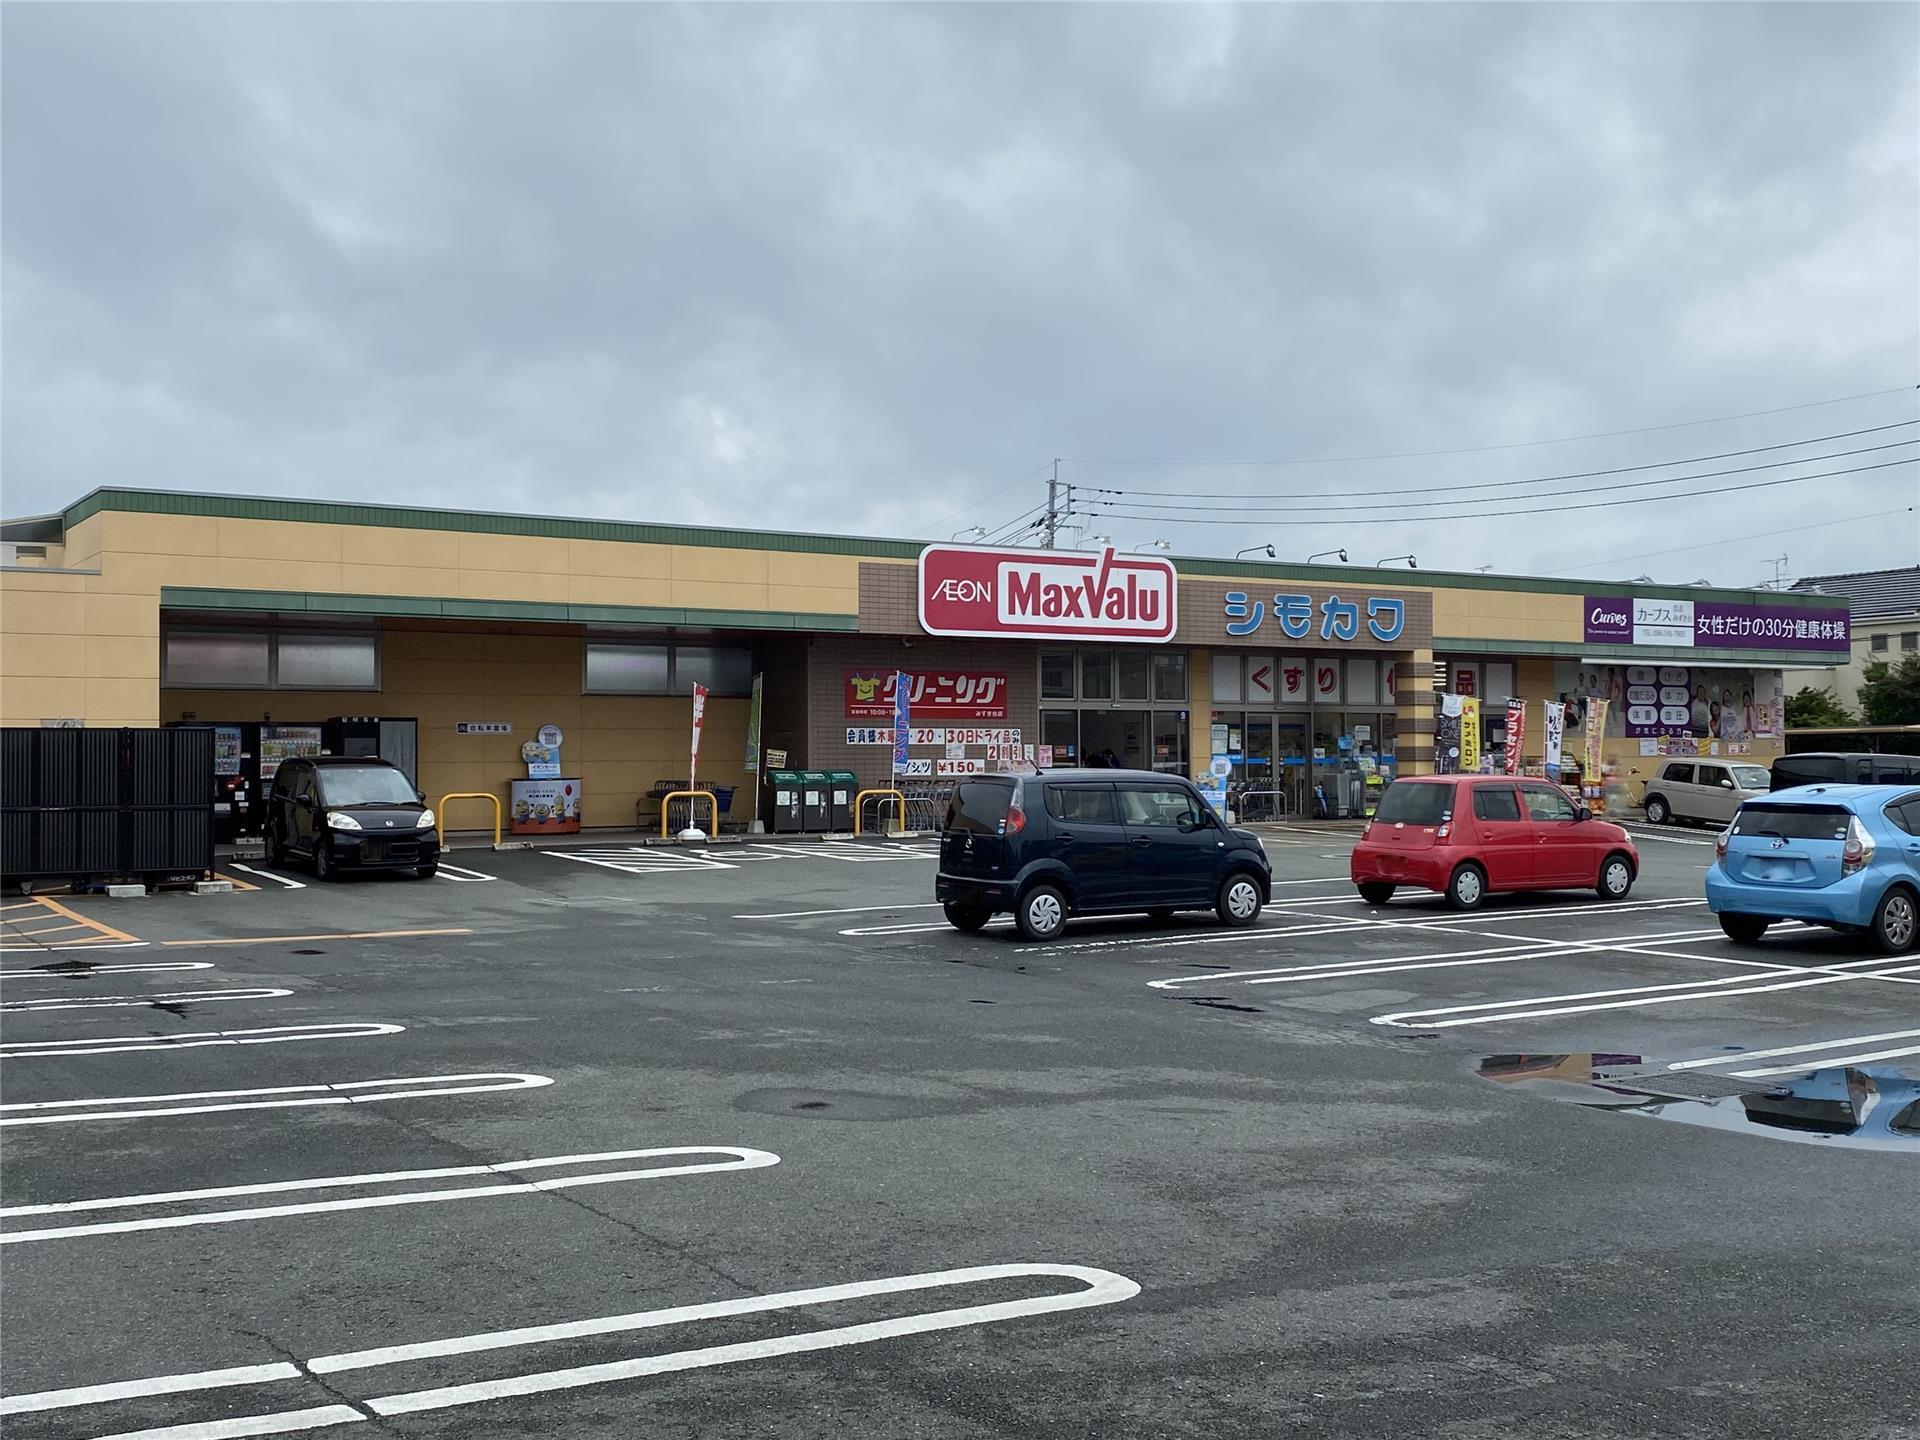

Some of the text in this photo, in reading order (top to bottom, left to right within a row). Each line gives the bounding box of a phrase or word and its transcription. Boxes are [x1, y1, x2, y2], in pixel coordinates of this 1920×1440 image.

[1007, 548, 1159, 622] MaxValu
[1224, 591, 1405, 642] シモカワ
[1591, 607, 1628, 627] Curves
[1637, 607, 1672, 622] カーブス
[1697, 614, 1846, 640] 女性だけの30分健康体操
[883, 674, 1005, 704] クリーニング
[1251, 664, 1338, 694] くすり
